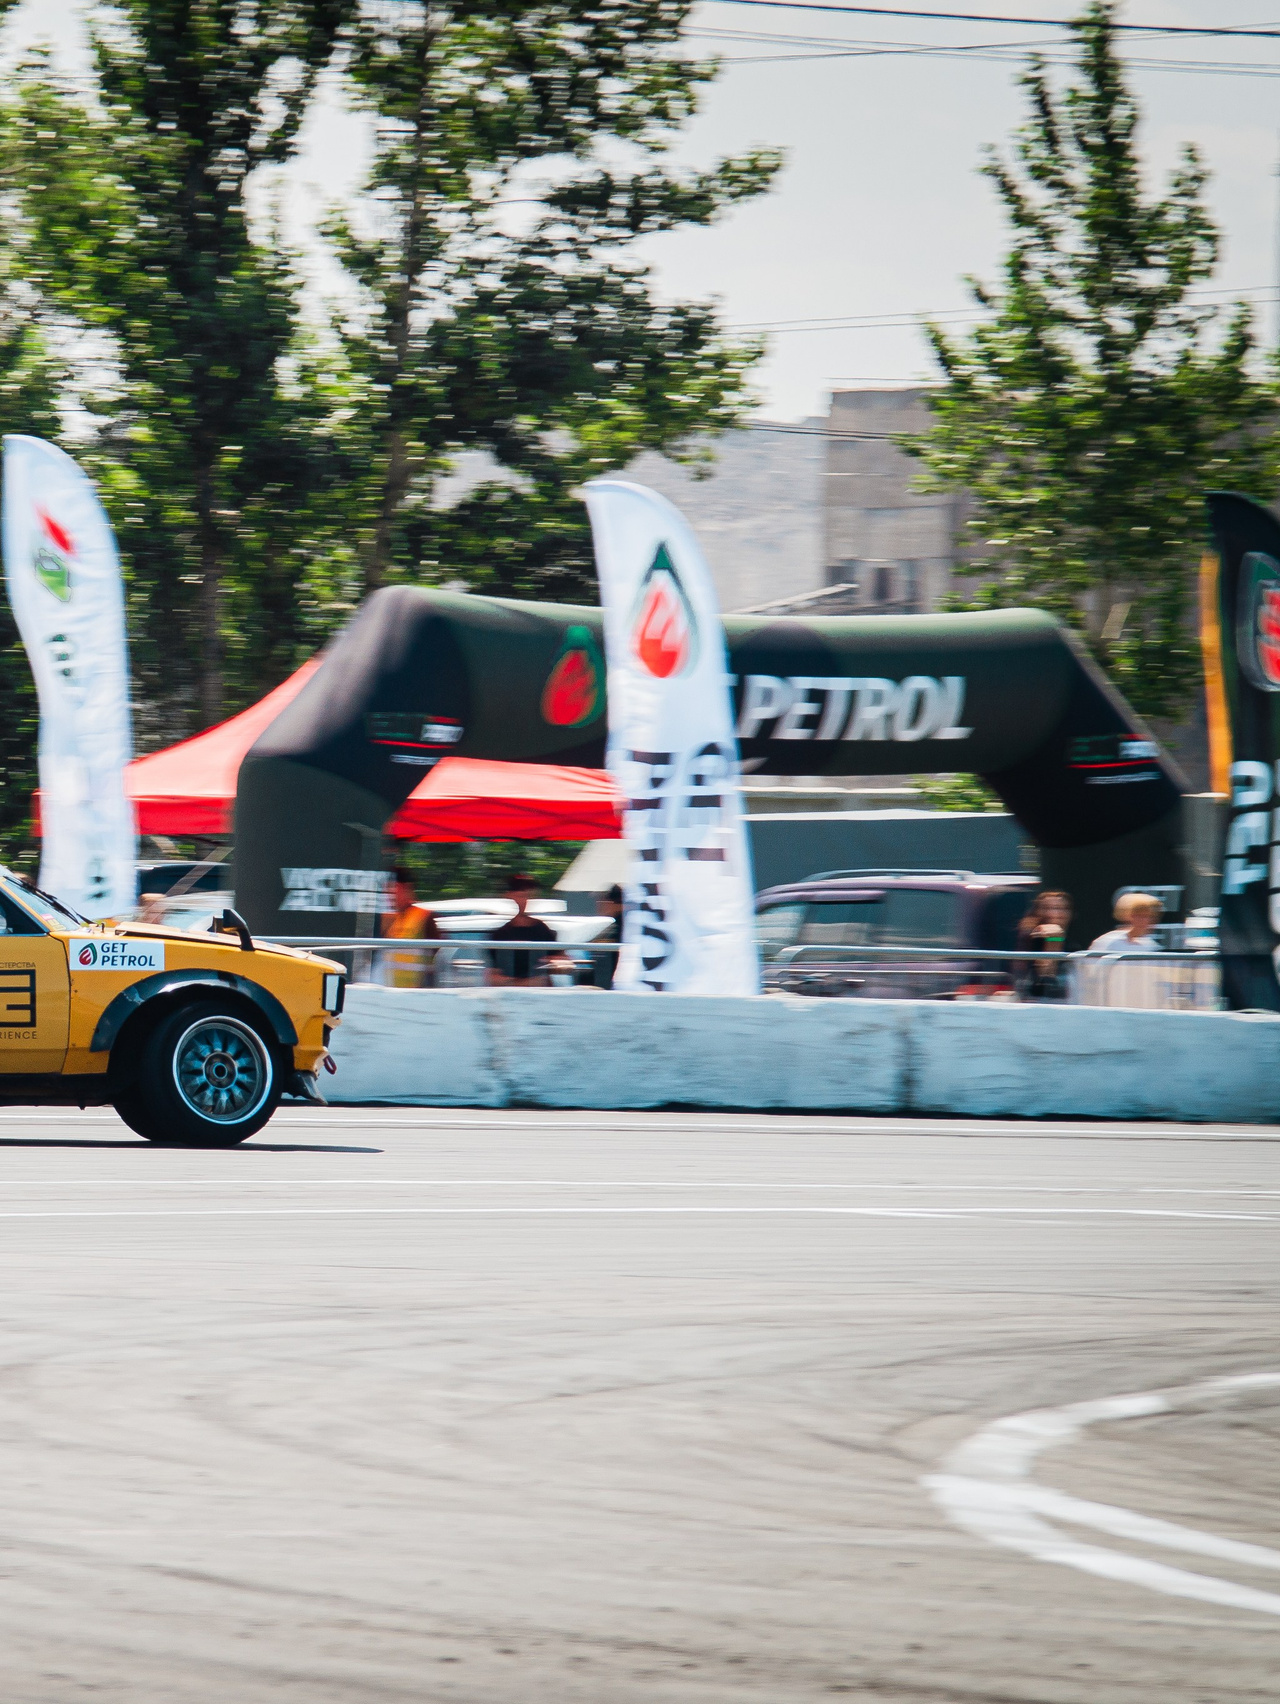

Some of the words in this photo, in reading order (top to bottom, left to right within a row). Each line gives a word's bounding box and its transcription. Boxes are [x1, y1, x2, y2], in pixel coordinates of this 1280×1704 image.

[734, 674, 975, 742] PETROL
[101, 942, 128, 953] GET
[101, 955, 156, 967] PETROL
